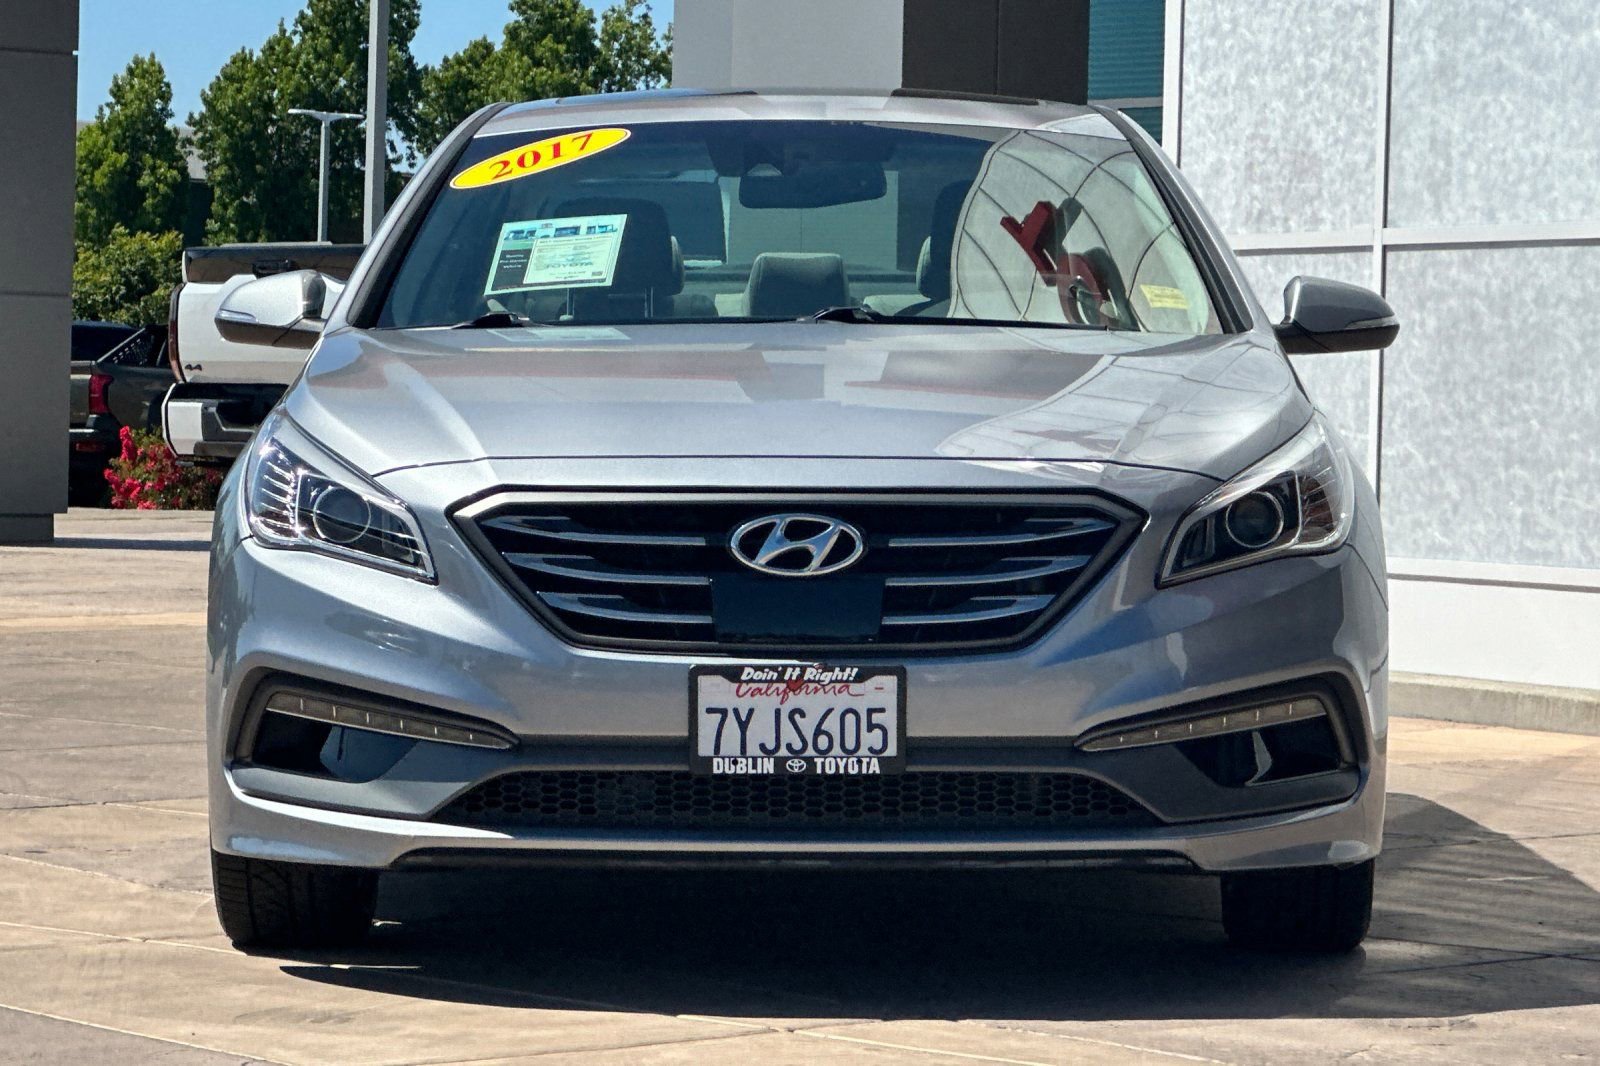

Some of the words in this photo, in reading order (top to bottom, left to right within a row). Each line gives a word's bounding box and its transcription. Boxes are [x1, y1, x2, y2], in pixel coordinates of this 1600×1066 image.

[489, 132, 593, 180] 2017
[740, 667, 782, 681] Doin'
[784, 667, 800, 681] It
[803, 667, 858, 685] Right!
[736, 682, 864, 705] California
[705, 707, 889, 756] 7YJS605
[713, 757, 775, 775] DUBLIN
[814, 757, 881, 775] TOYOTA
